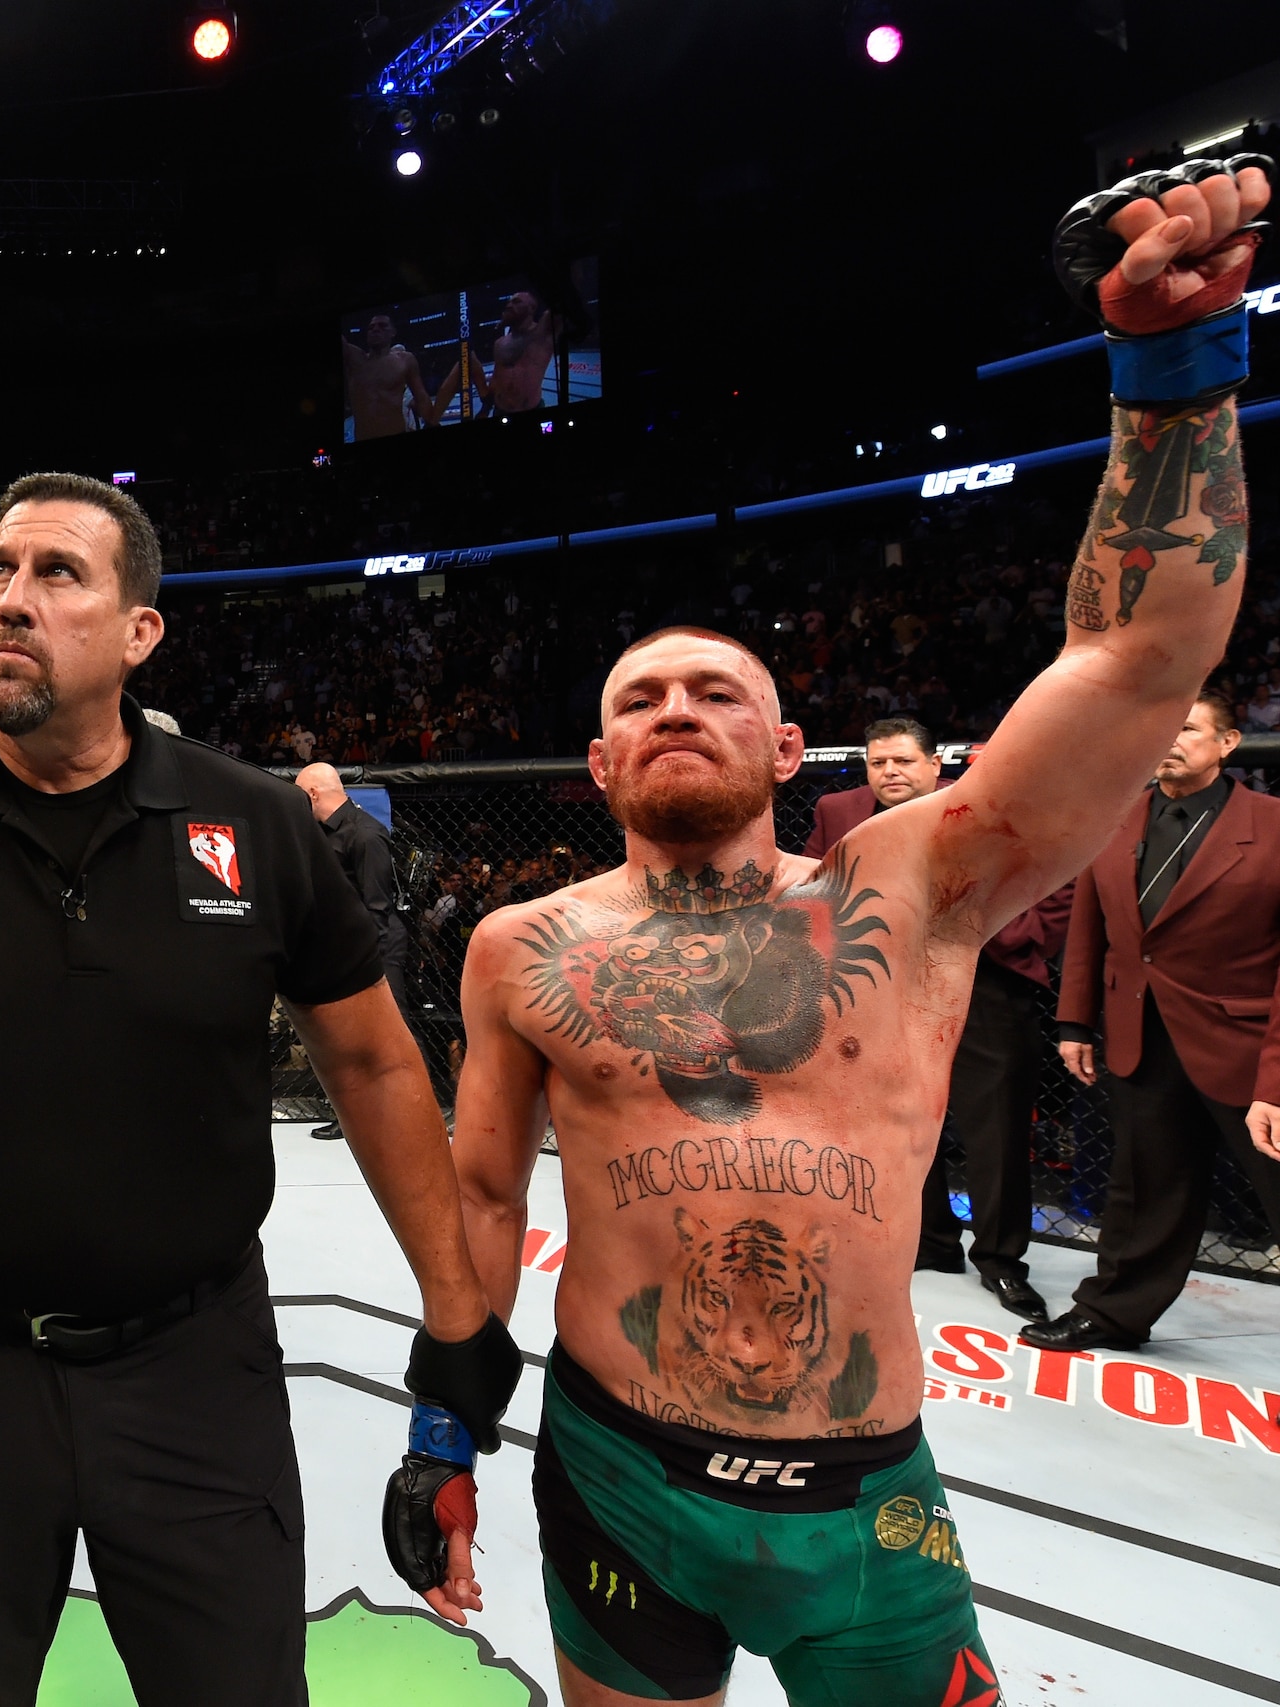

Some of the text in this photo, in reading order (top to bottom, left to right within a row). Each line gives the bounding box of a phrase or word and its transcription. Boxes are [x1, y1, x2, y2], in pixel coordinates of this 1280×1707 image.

[1242, 284, 1280, 316] FC
[819, 753, 847, 762] NOW
[189, 899, 251, 909] NEVADA ATHLETIC
[199, 907, 244, 916] COMMISSION
[706, 1452, 816, 1487] UFC
[895, 1502, 915, 1514] UFC
[885, 1512, 920, 1527] WORLD
